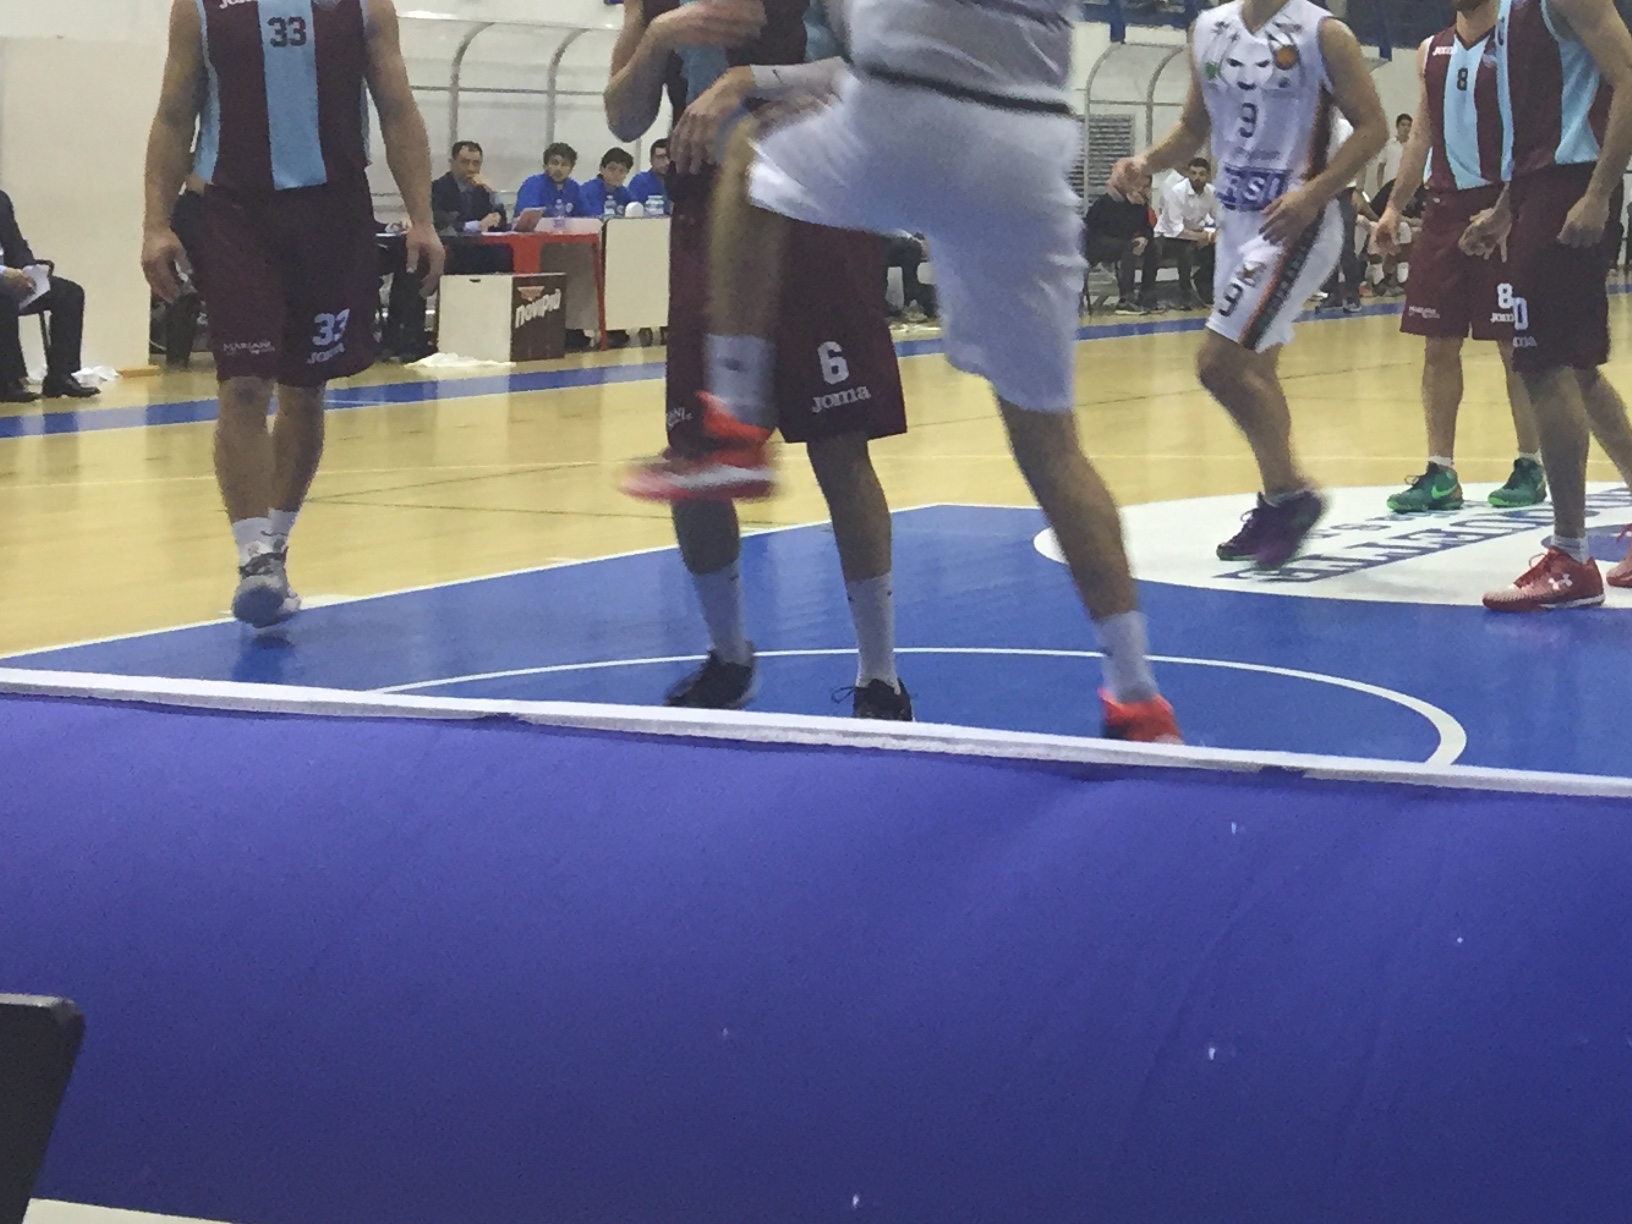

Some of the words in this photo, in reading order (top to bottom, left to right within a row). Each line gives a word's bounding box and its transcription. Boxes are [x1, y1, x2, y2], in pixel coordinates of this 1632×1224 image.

[267, 16, 307, 47] 33
[1456, 67, 1469, 91] 8
[1496, 282, 1514, 309] 8
[817, 341, 850, 385] 6
